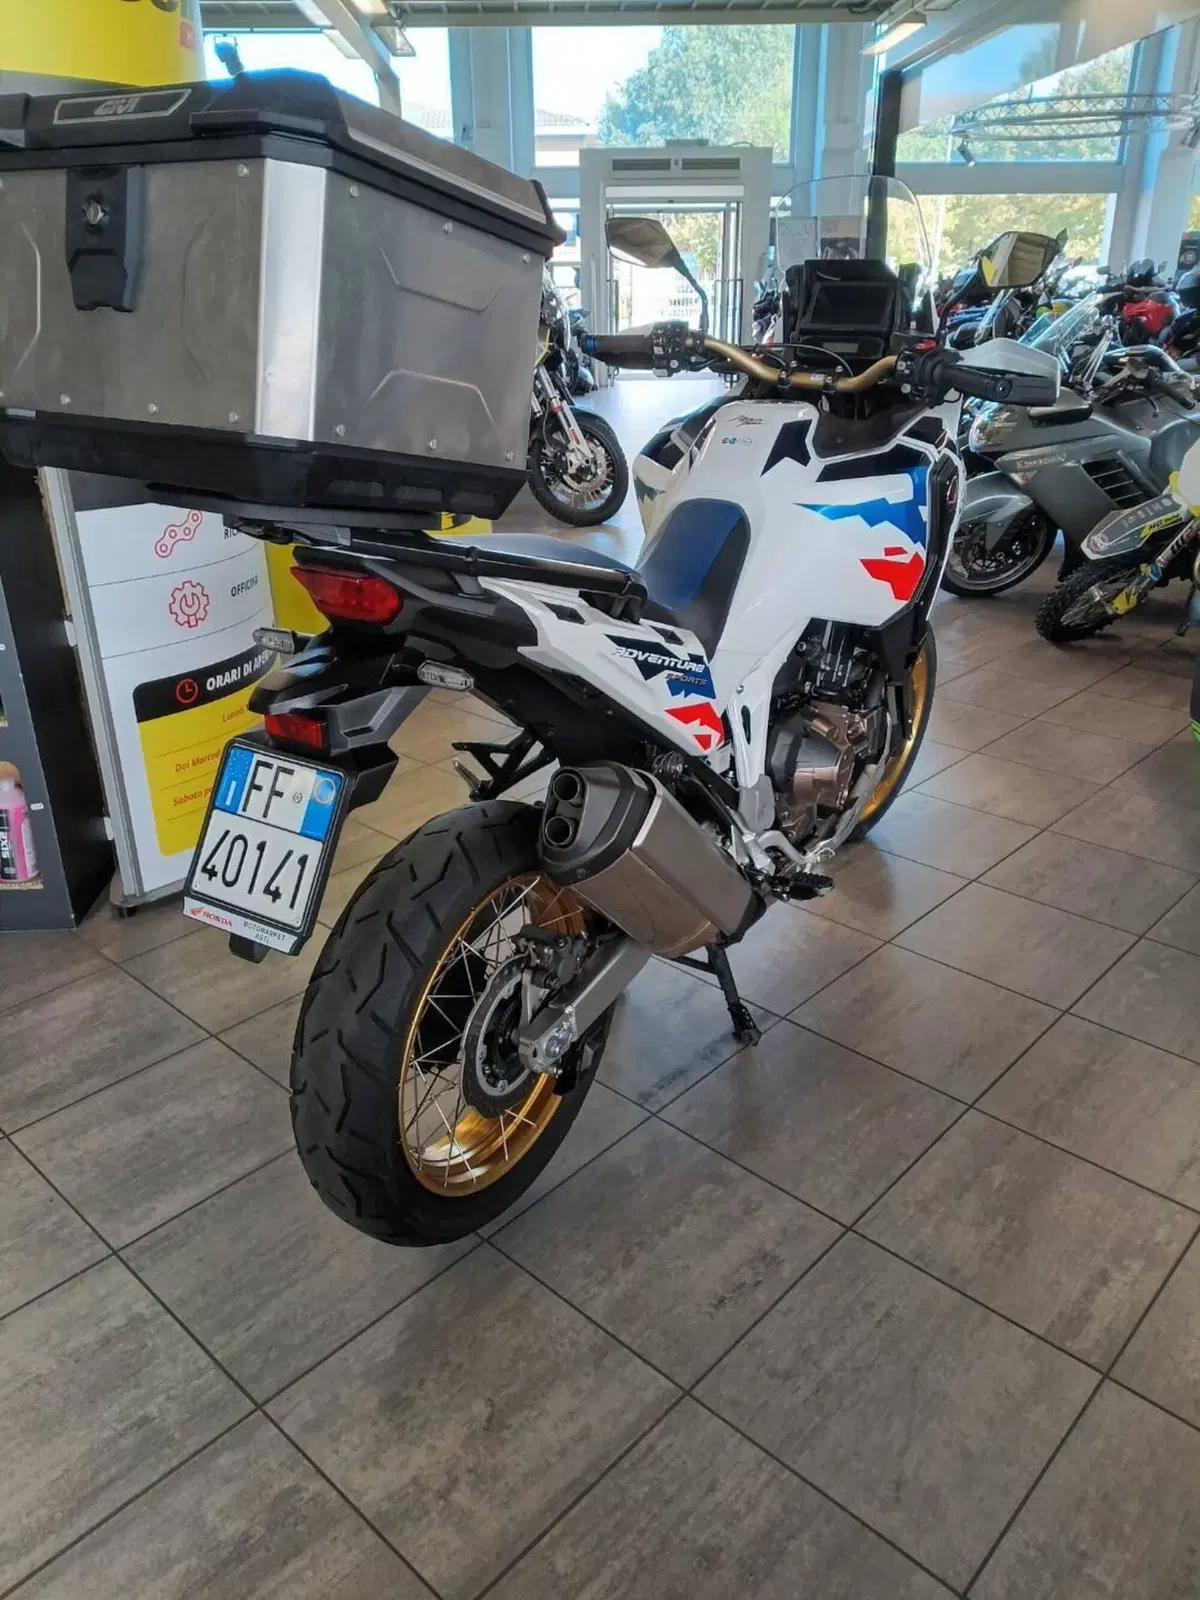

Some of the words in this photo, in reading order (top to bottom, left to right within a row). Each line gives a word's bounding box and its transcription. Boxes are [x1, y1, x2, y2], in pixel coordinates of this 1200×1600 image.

[612, 646, 705, 673] ADVENTURE
[206, 667, 241, 691] ORARI
[243, 660, 253, 677] DI
[664, 672, 708, 686] SPORTS
[173, 790, 203, 807] Sabato
[241, 759, 294, 819] FF
[201, 829, 309, 911] 40141
[202, 910, 233, 928] HONDA
[243, 920, 287, 941] MOTOMARKET
